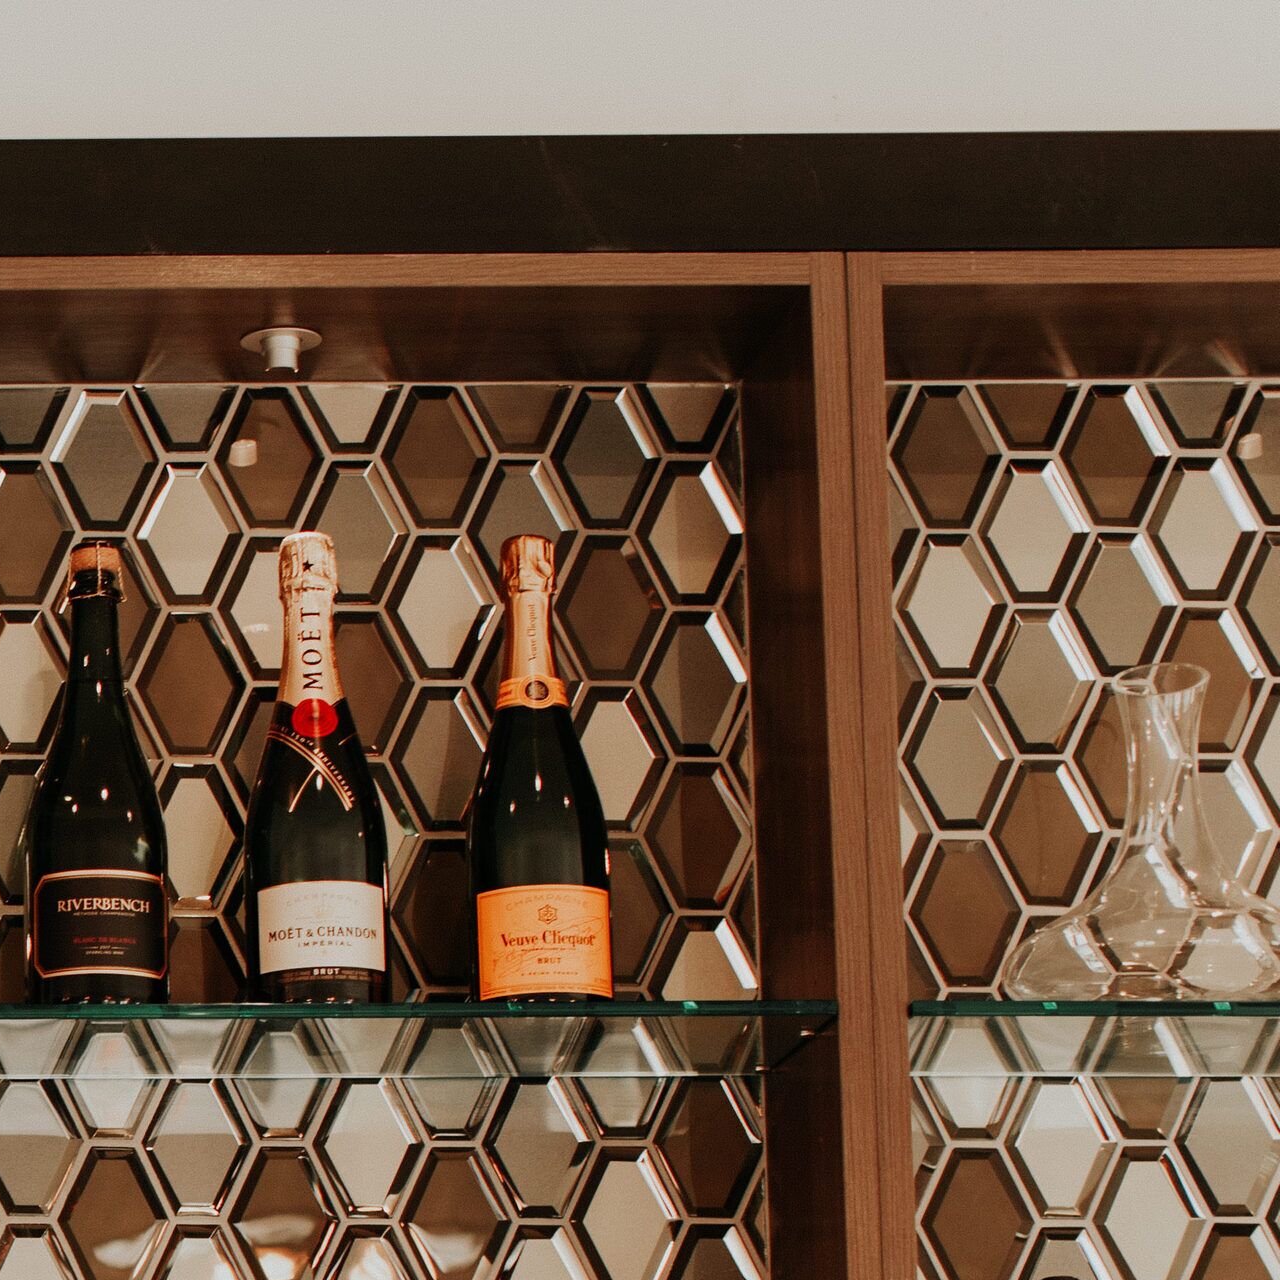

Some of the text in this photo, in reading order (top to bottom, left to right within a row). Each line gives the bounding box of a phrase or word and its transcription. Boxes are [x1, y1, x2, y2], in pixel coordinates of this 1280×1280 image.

[297, 606, 323, 690] MOËT
[57, 898, 150, 913] RIVERBENCH
[268, 926, 378, 944] MOËT & CHANDON
[500, 929, 596, 949] Veuve Clicquot
[537, 957, 562, 965] BRUT
[313, 968, 341, 976] BRUT
